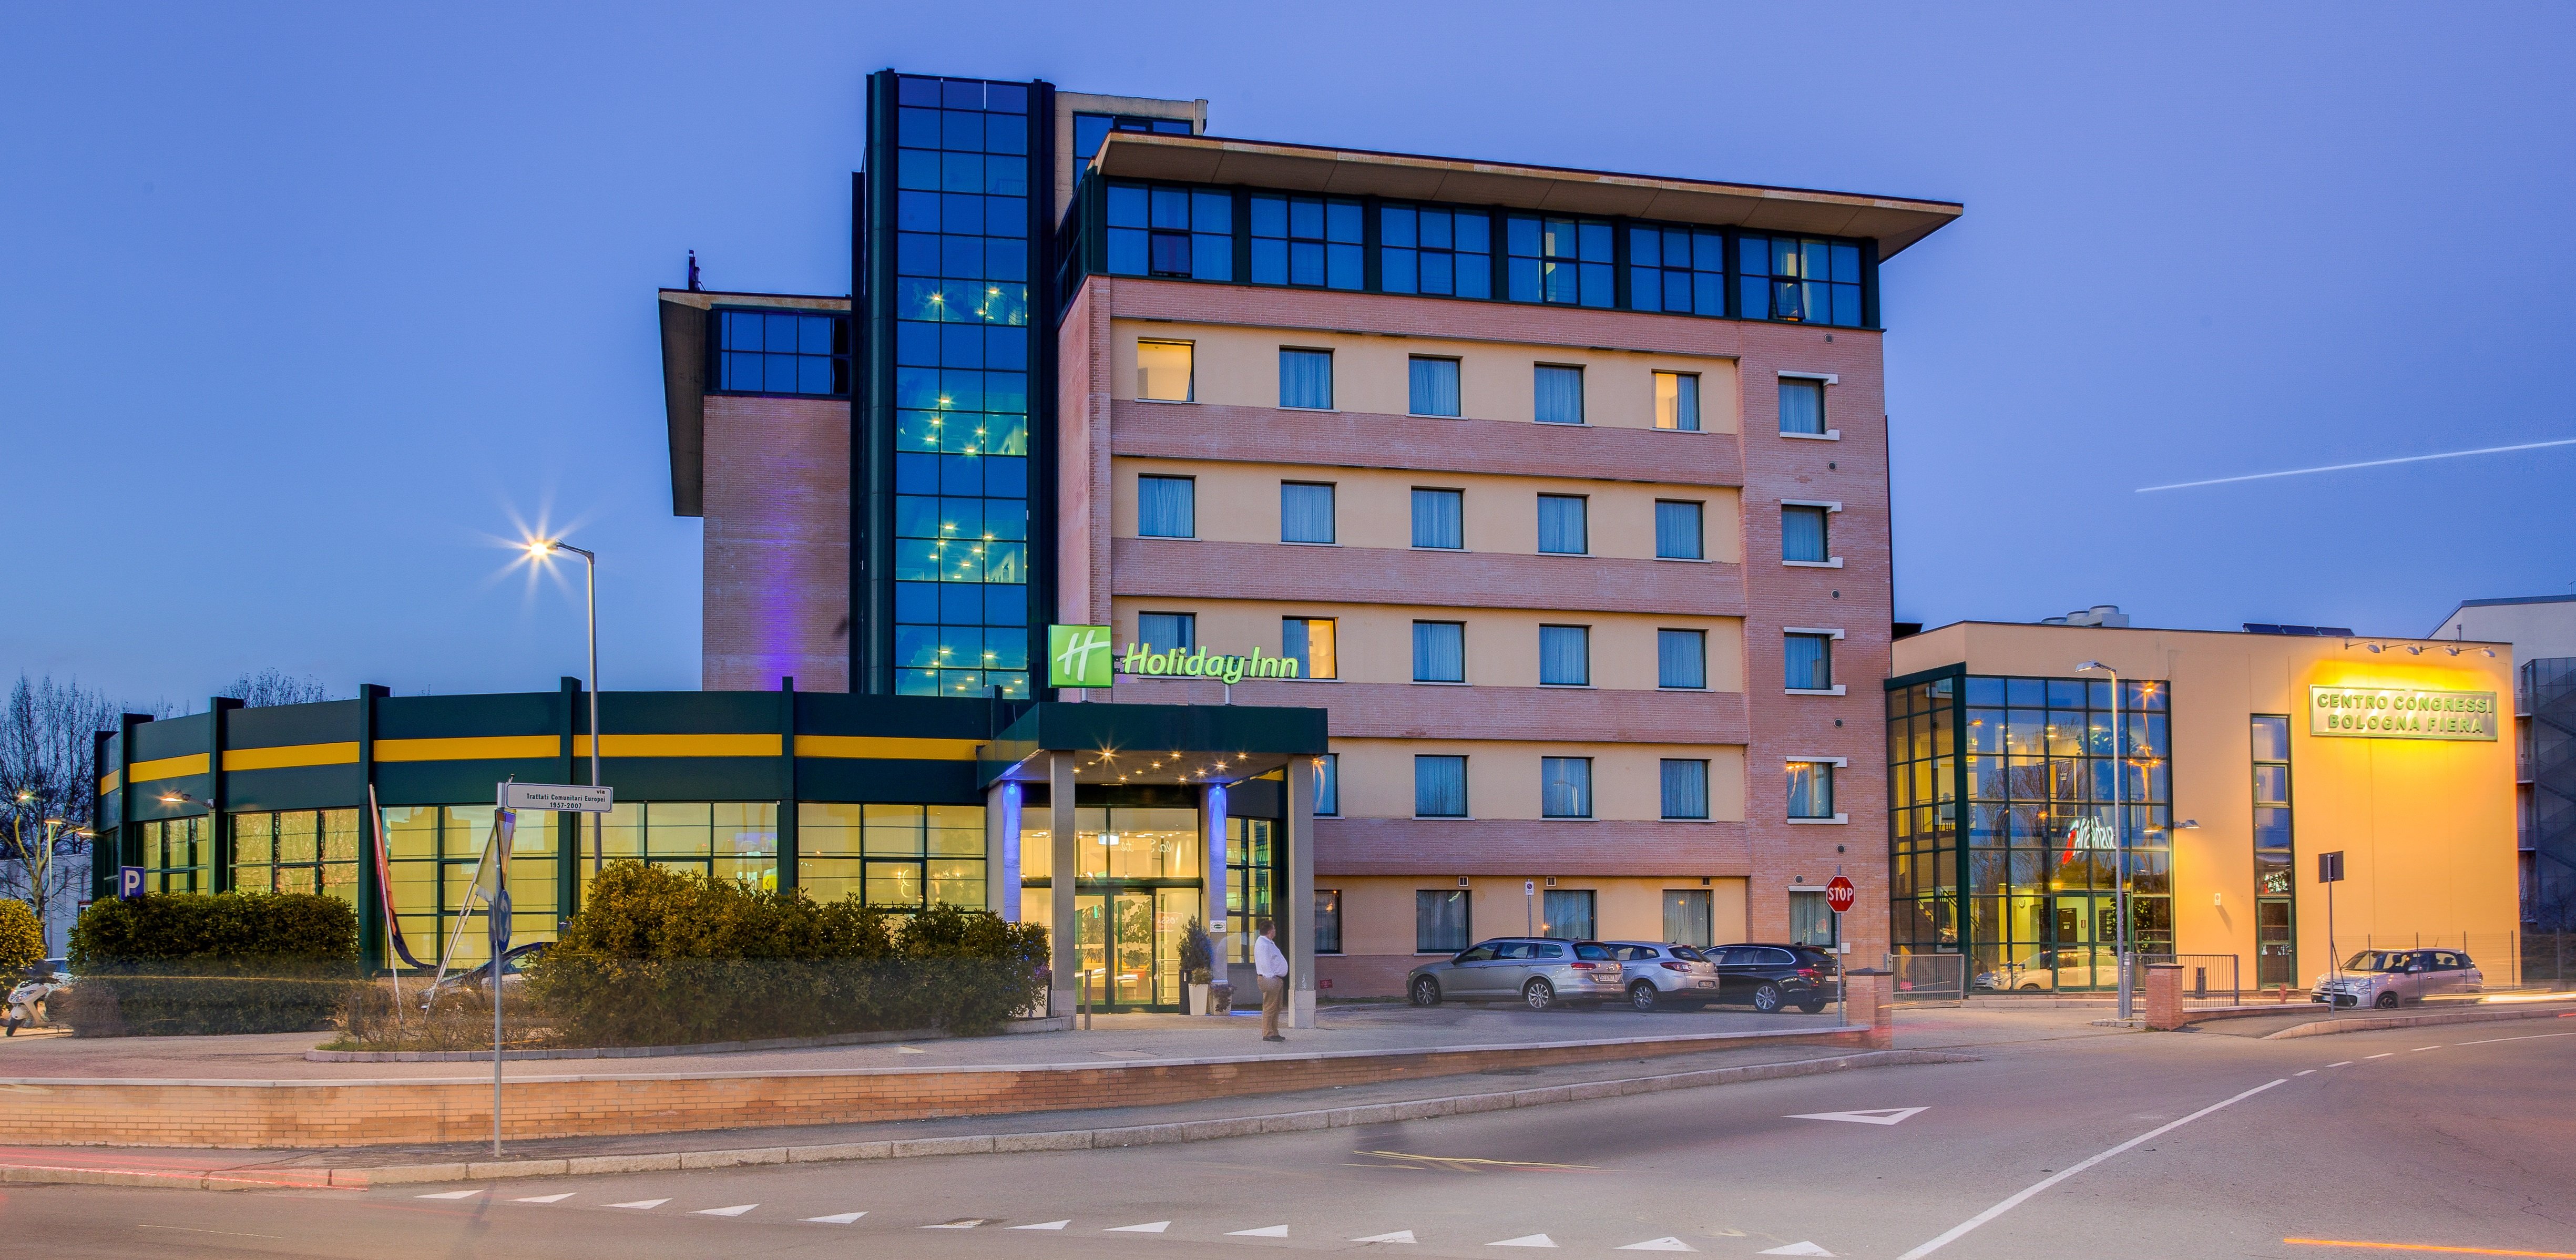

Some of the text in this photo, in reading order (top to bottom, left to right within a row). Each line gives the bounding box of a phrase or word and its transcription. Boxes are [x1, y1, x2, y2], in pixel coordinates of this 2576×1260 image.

[1122, 643, 1298, 684] Holiday Inn
[2318, 693, 2493, 713] CENTRO CONGRESSI
[2328, 714, 2484, 733] BOLOGNA FIERA
[125, 870, 140, 897] P
[1828, 887, 1853, 901] STOP
